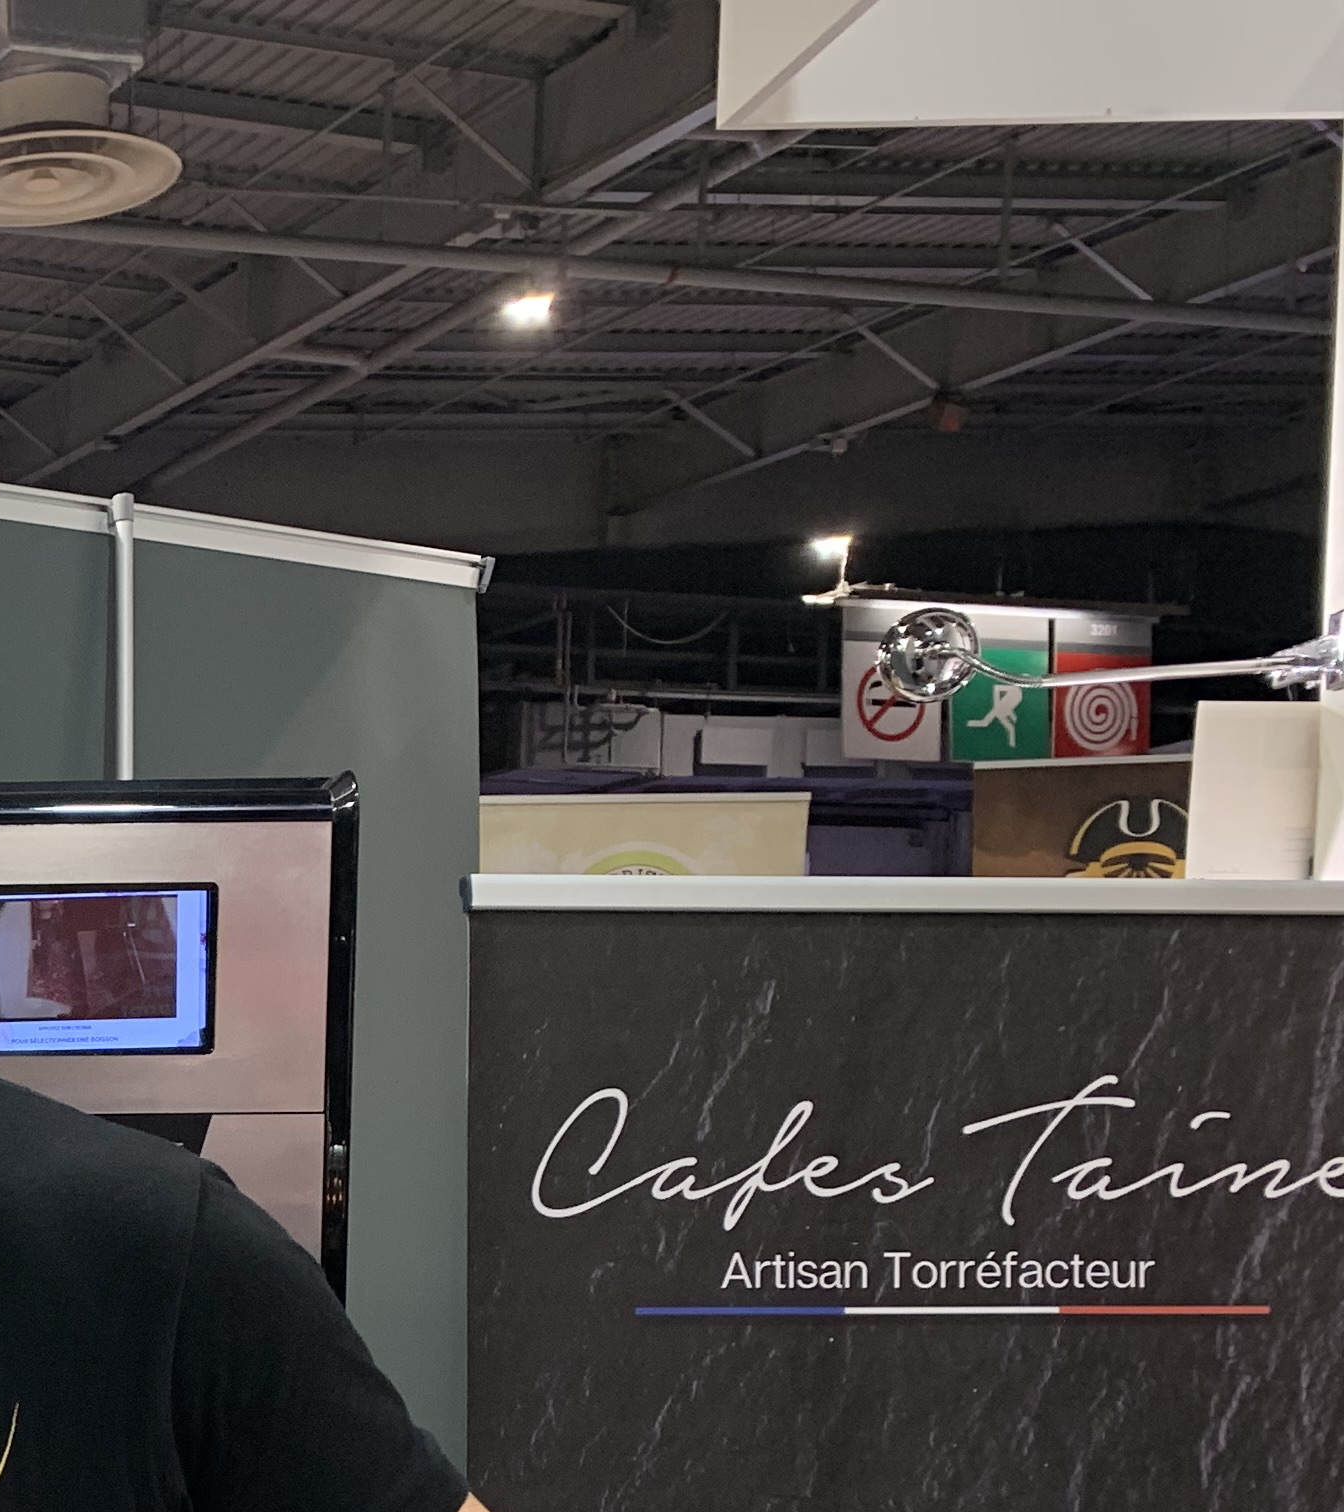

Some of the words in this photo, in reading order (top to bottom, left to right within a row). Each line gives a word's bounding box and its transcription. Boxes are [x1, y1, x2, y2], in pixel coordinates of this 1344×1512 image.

[531, 1087, 935, 1231] Cafes
[962, 1074, 1344, 1227] Taine
[721, 1252, 869, 1290] Artisan
[884, 1250, 1155, 1290] Torréfacteur
